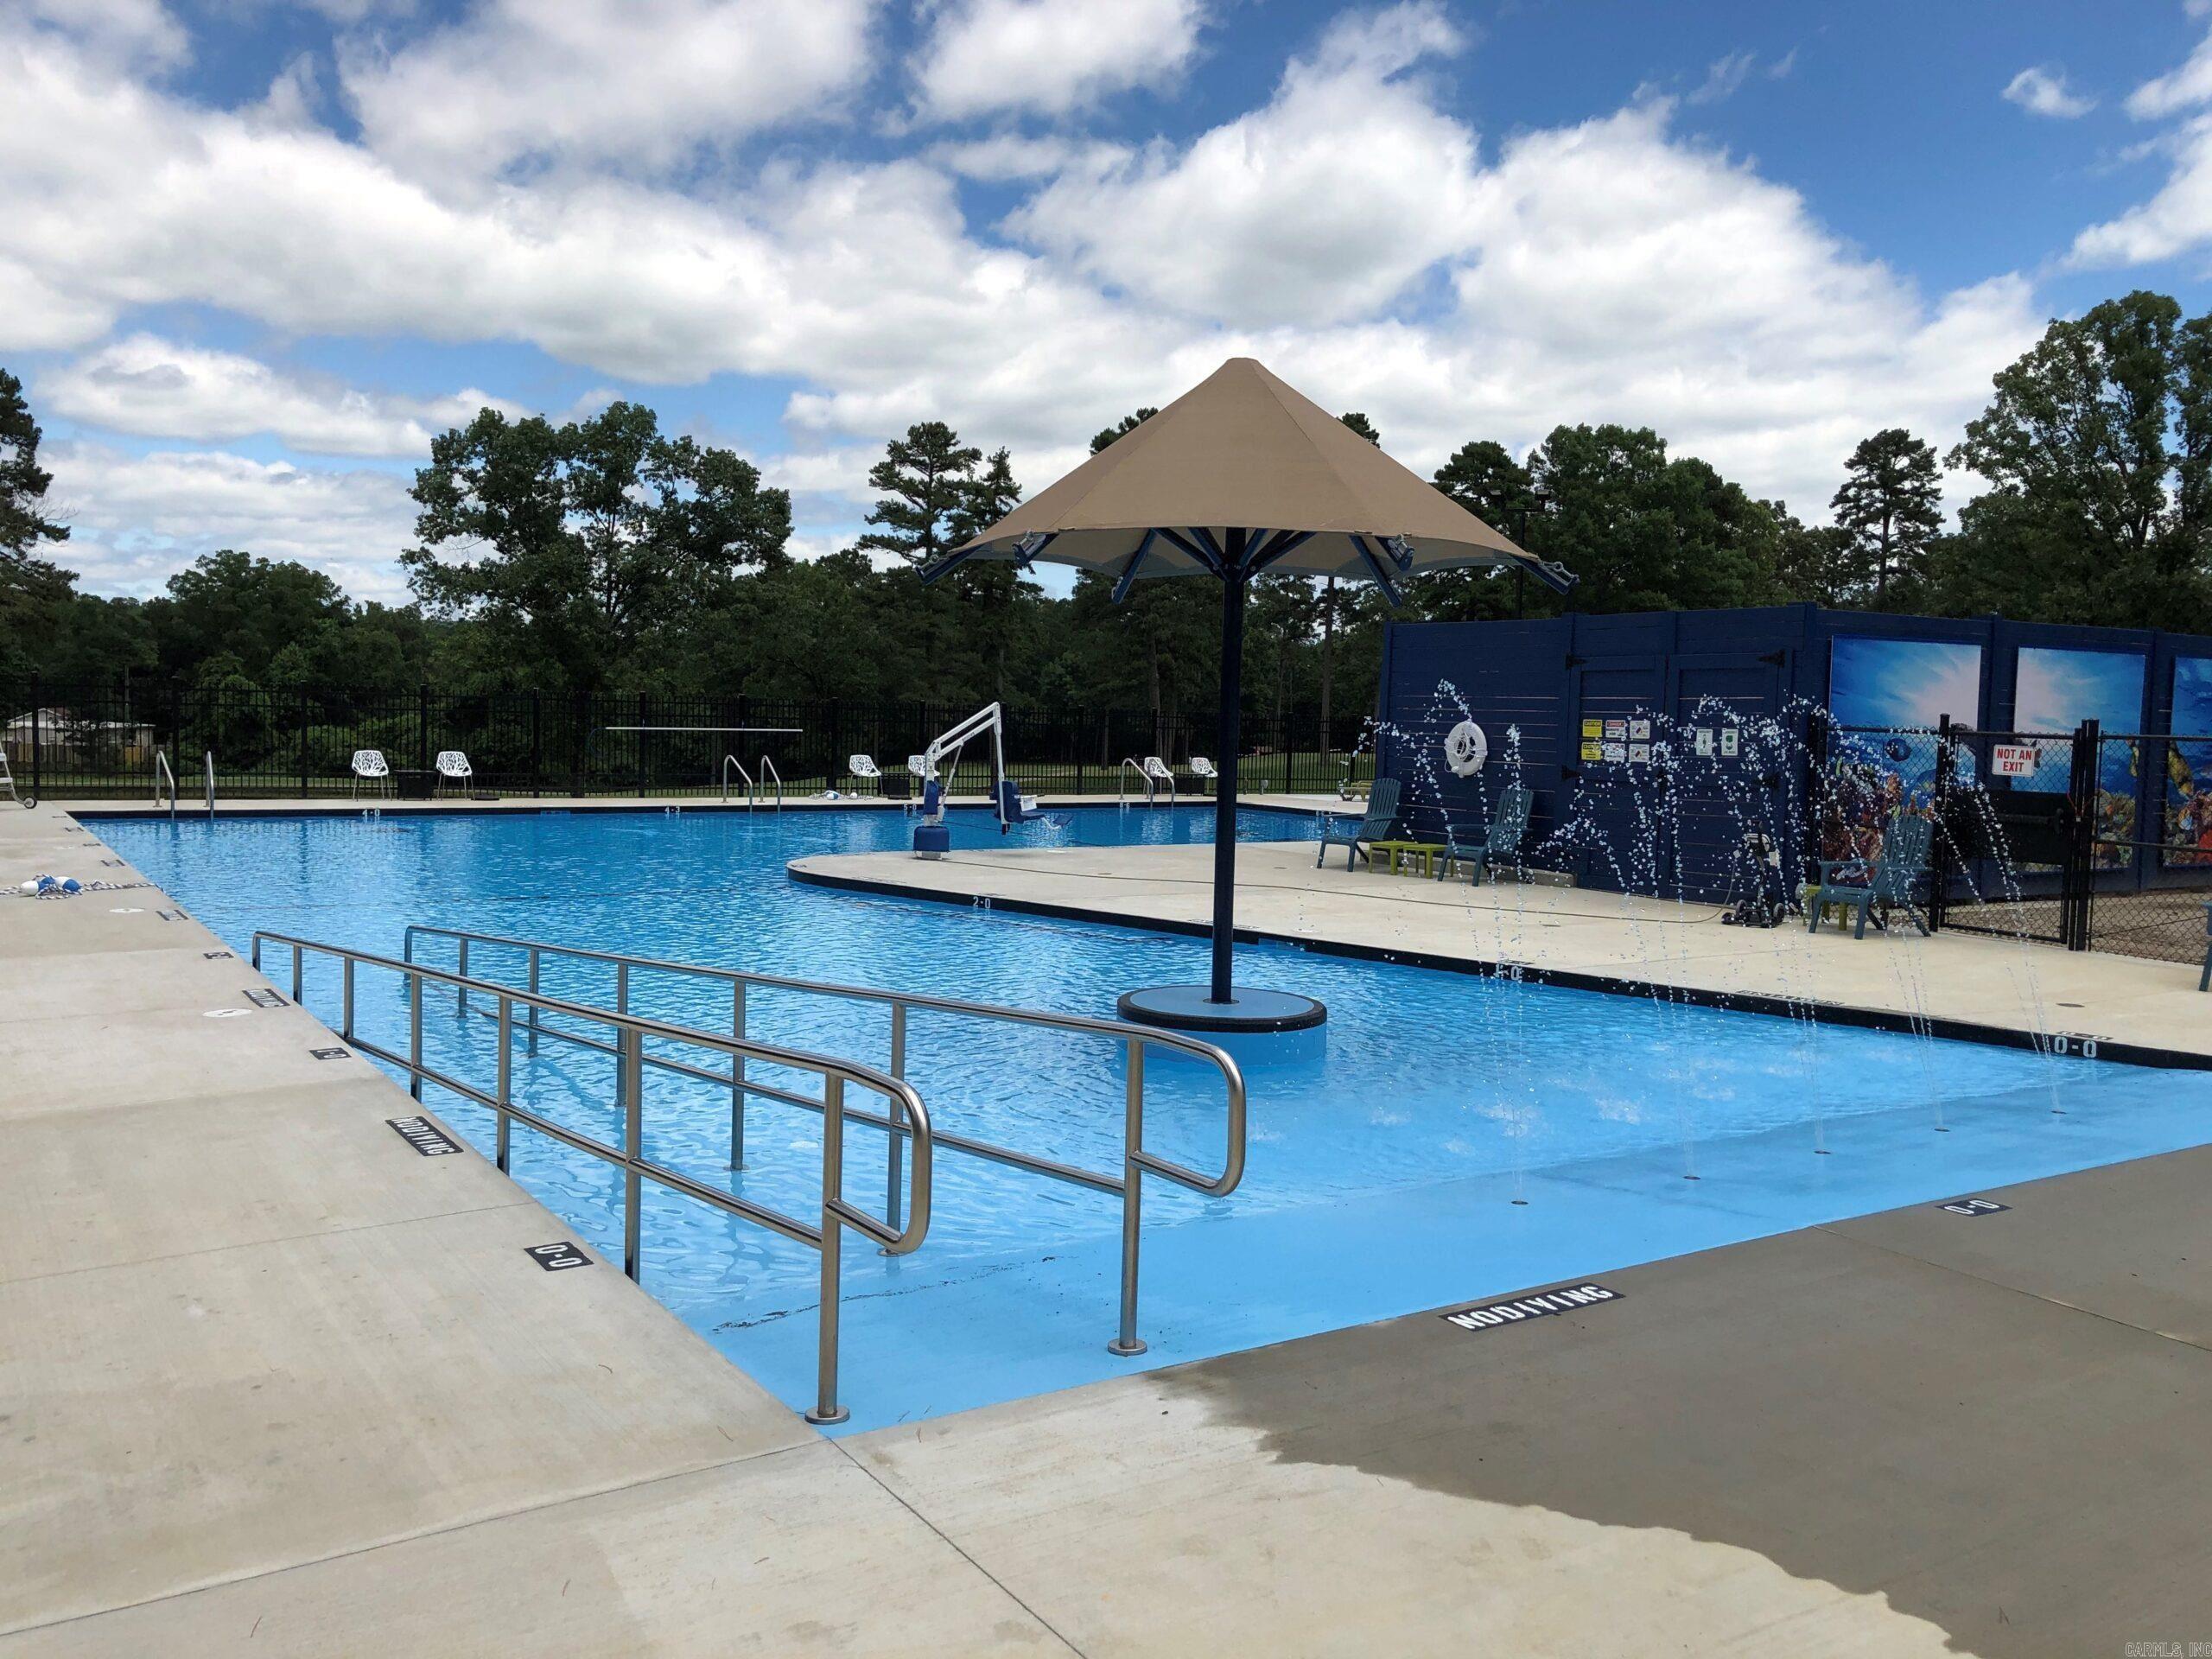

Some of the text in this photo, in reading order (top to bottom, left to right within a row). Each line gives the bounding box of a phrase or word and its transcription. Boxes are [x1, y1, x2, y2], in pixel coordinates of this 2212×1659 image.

[1997, 748, 2032, 760] NOT AN
[2003, 761, 2024, 772] EXIT
[973, 895, 991, 909] 2-0
[2054, 1036, 2097, 1058] 0-0
[1943, 1199, 2000, 1215] 0-0
[534, 1244, 582, 1268] 0-0
